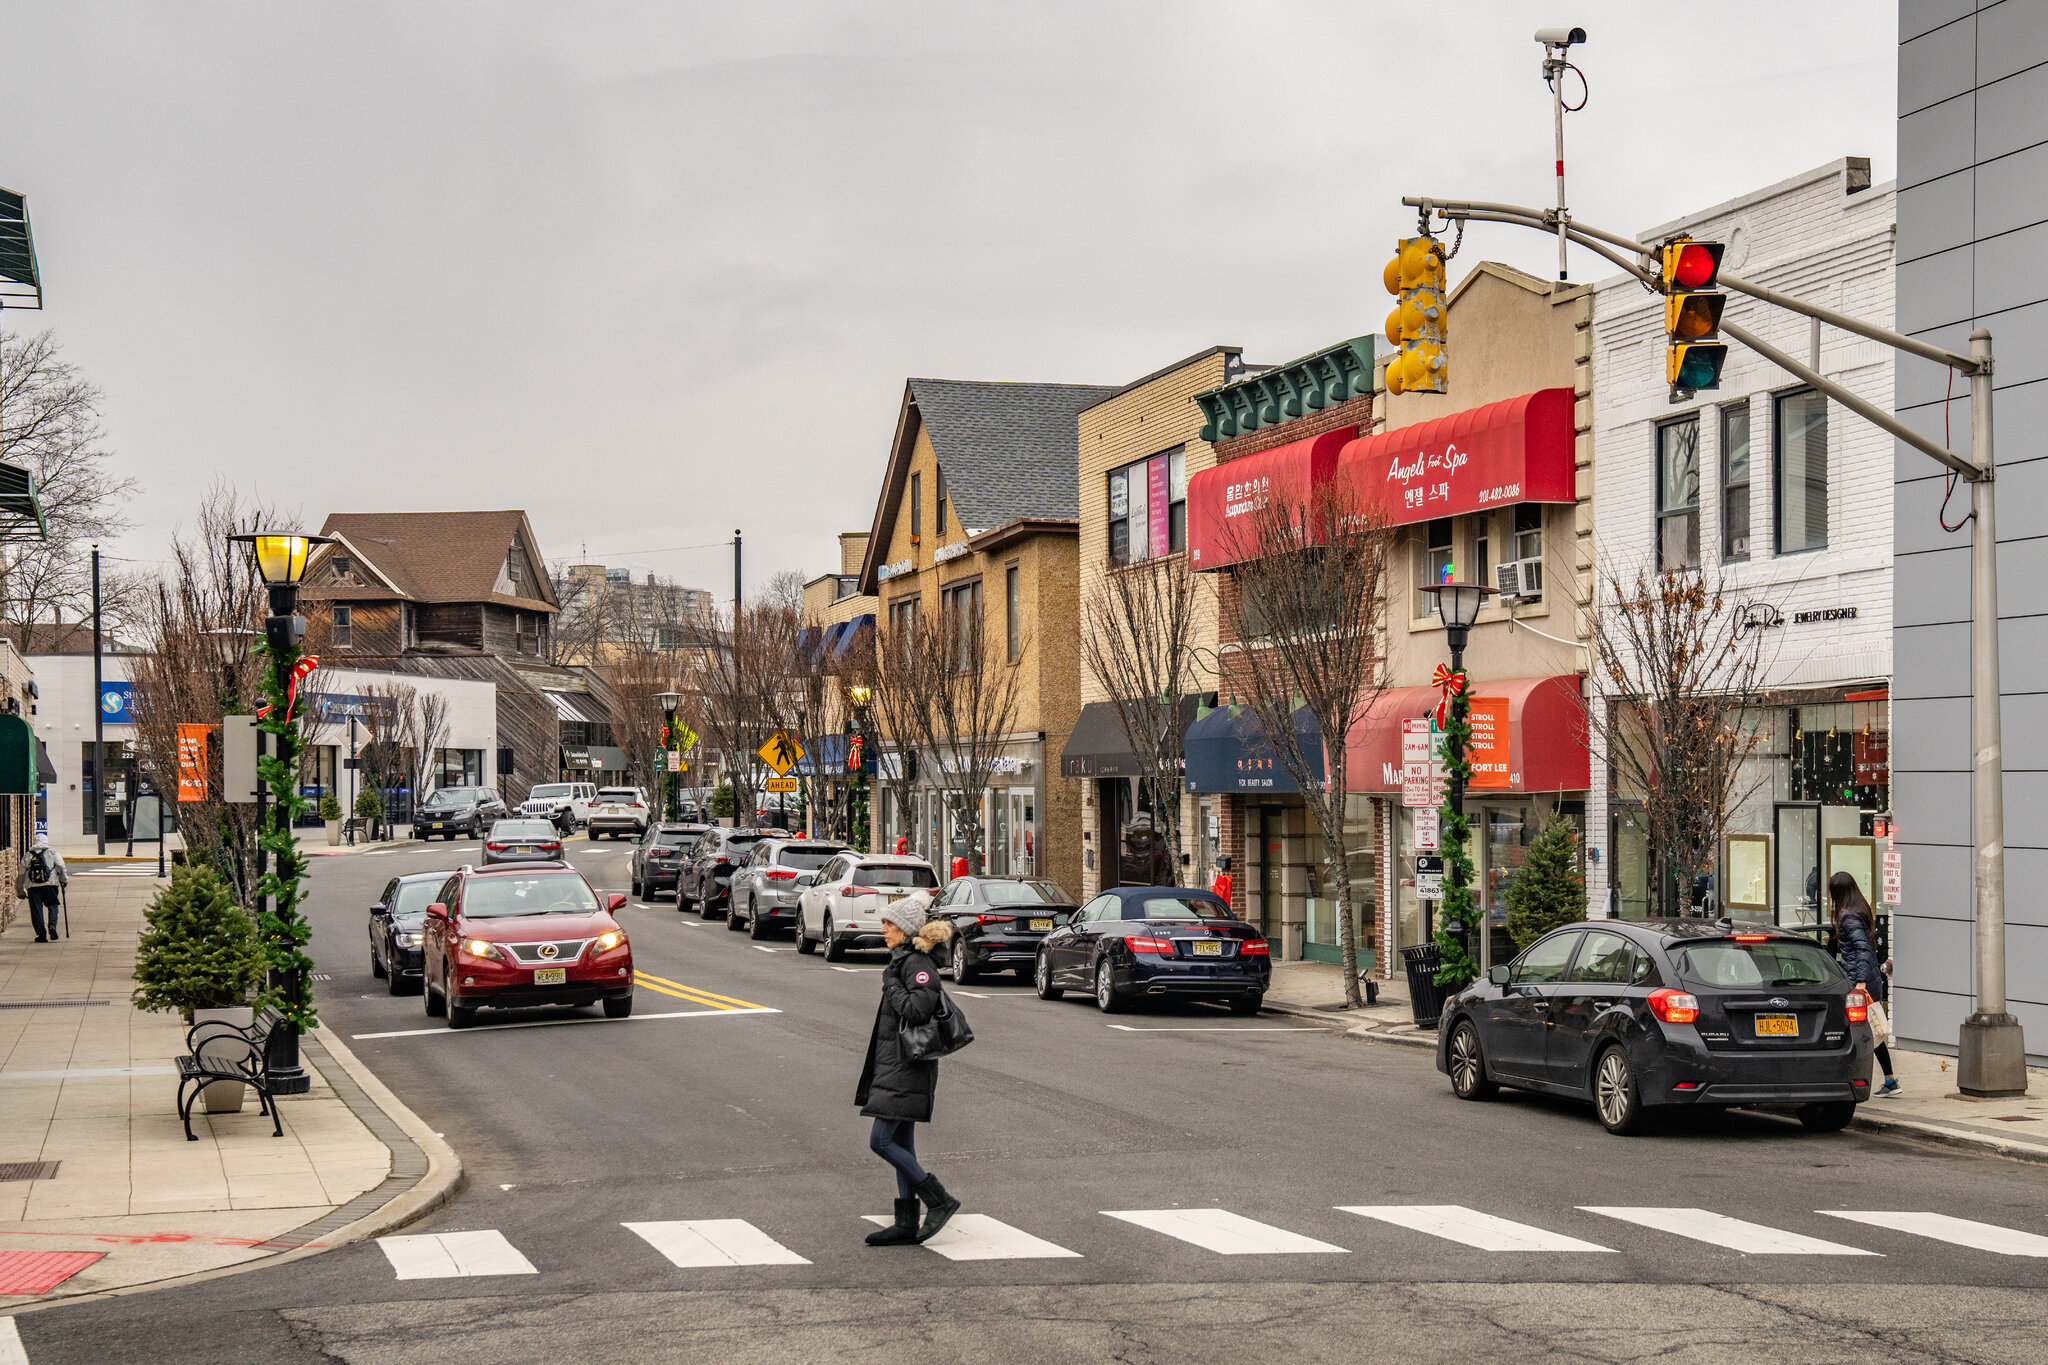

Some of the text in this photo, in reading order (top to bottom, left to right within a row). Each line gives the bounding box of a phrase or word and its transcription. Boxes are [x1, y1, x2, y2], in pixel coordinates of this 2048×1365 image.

[1386, 444, 1468, 485] Angels Foot Spa
[1404, 482, 1449, 508] 엔젤 스파
[1479, 483, 1520, 503] 201-482-0086
[1794, 608, 1857, 624] JEWELRY DESIGNER
[1070, 756, 1091, 774] raku
[1471, 764, 1507, 772] FORT LEE
